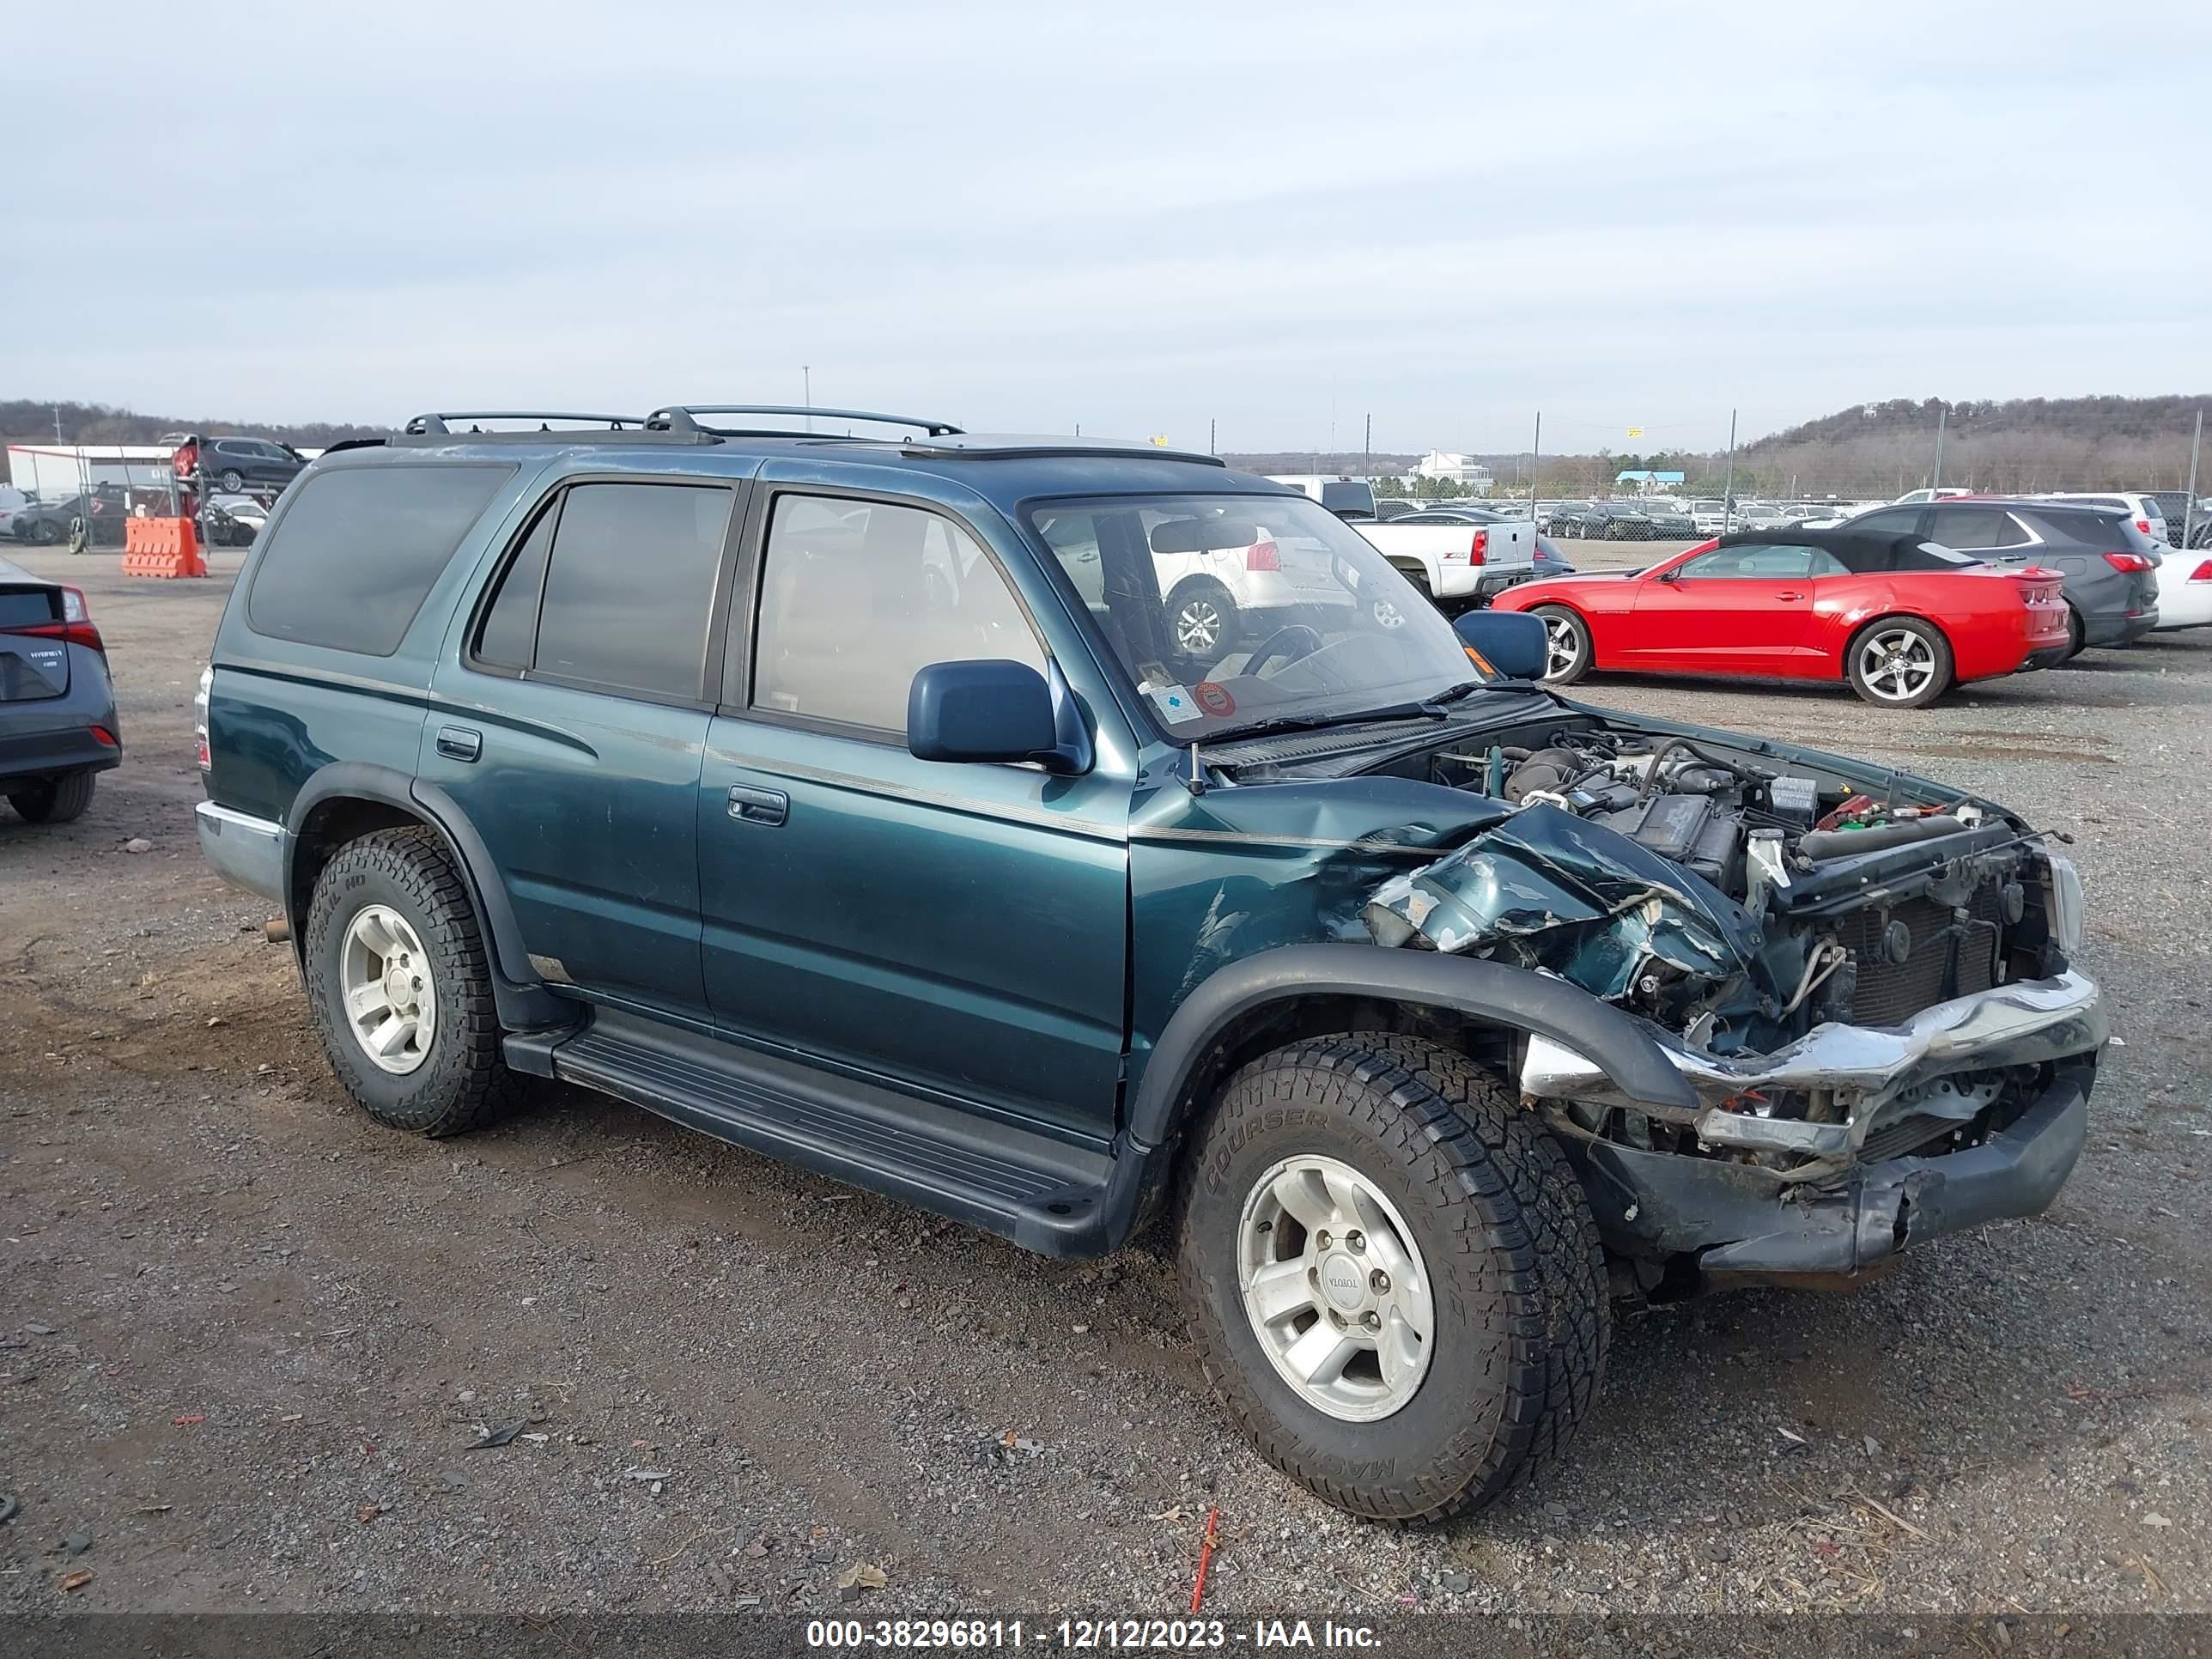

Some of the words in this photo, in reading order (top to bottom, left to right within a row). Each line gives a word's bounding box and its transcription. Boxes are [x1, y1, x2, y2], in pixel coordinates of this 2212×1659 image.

[318, 893, 341, 953] TRAIL
[344, 874, 366, 891] HD
[1206, 1108, 1328, 1195] COURSER
[1351, 1129, 1437, 1231] TRAIL
[1329, 1278, 1358, 1288] TOYOTA
